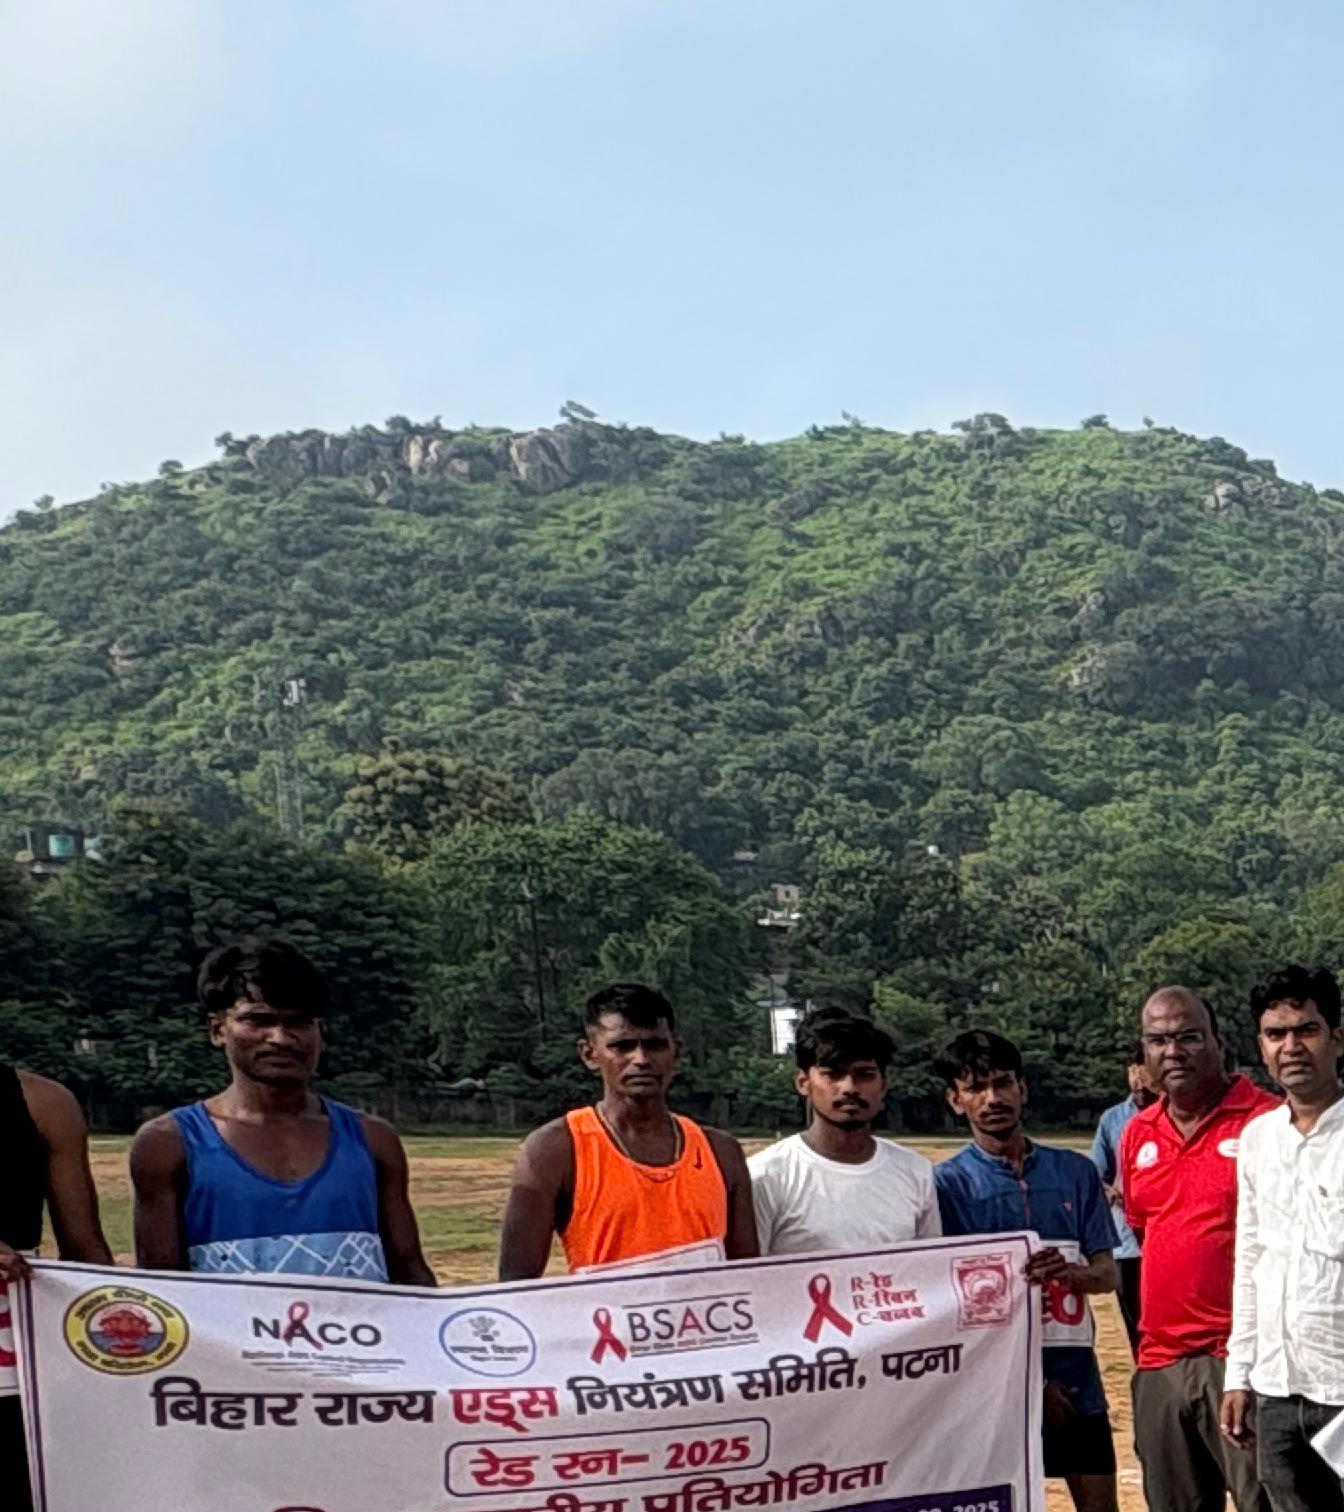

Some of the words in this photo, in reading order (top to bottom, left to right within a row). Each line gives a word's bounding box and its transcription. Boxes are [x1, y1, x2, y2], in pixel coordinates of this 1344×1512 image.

[253, 1302, 382, 1350] NACO
[627, 1300, 754, 1342] BSACS
[150, 1376, 303, 1430] बिहार
[312, 1390, 437, 1426] राज्य
[449, 1387, 559, 1433] एड्स
[567, 1373, 724, 1416] नियंत्रण
[731, 1347, 867, 1401] समिति,
[881, 1343, 964, 1380] पटना
[469, 1448, 540, 1487] रेड
[665, 1436, 750, 1470] 2025
